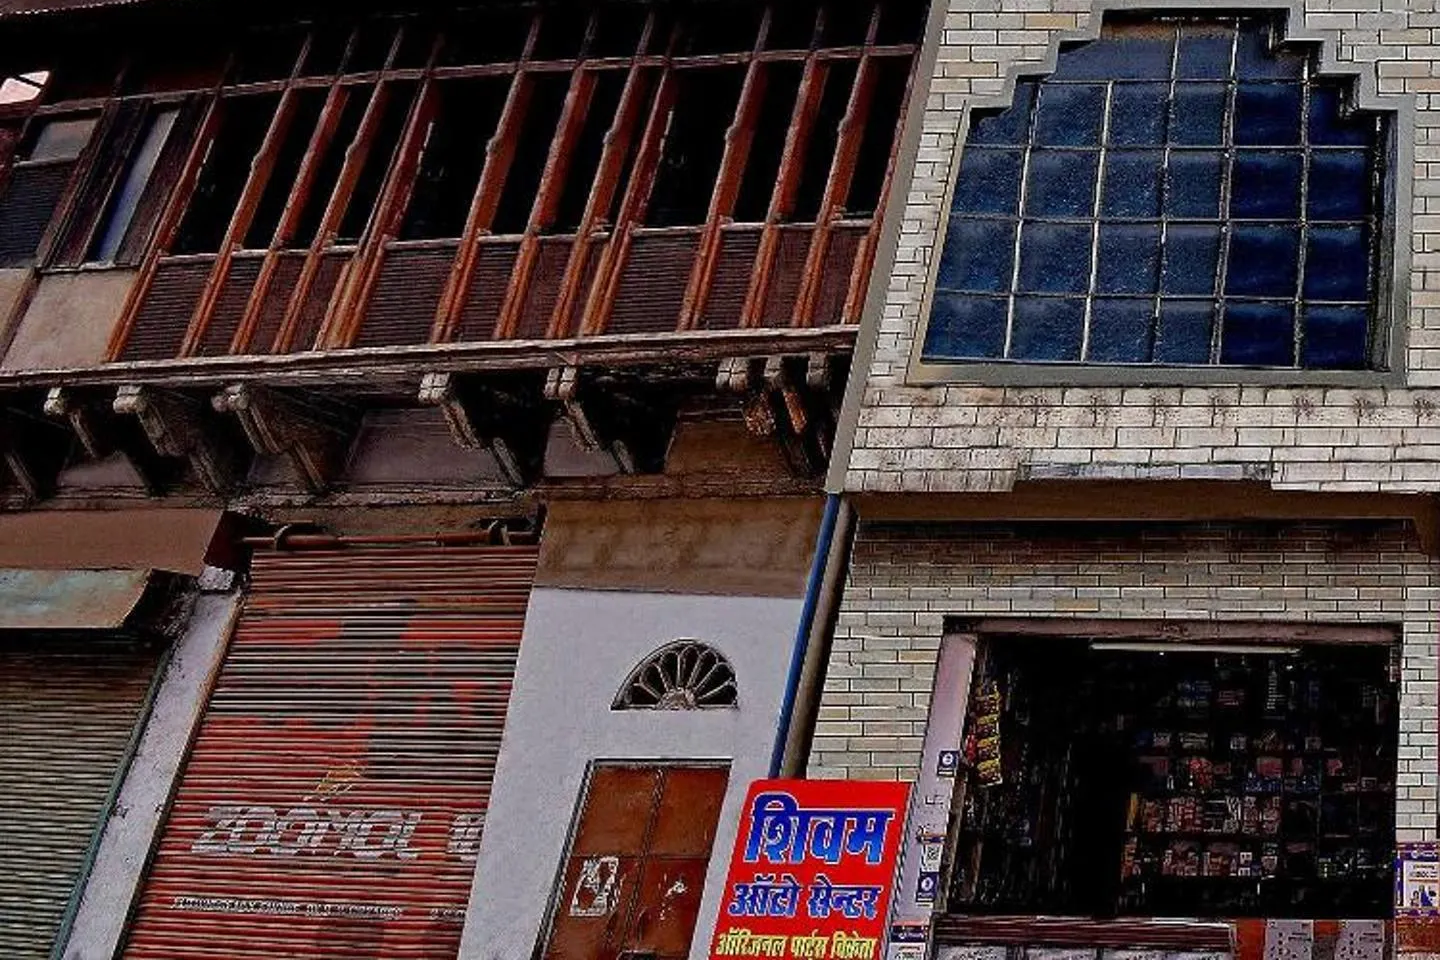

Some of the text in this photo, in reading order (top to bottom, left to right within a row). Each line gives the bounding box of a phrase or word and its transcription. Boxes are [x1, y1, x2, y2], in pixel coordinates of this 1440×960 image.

[743, 792, 897, 864] शिवम
[728, 873, 884, 921] ऑटो सेन्टर
